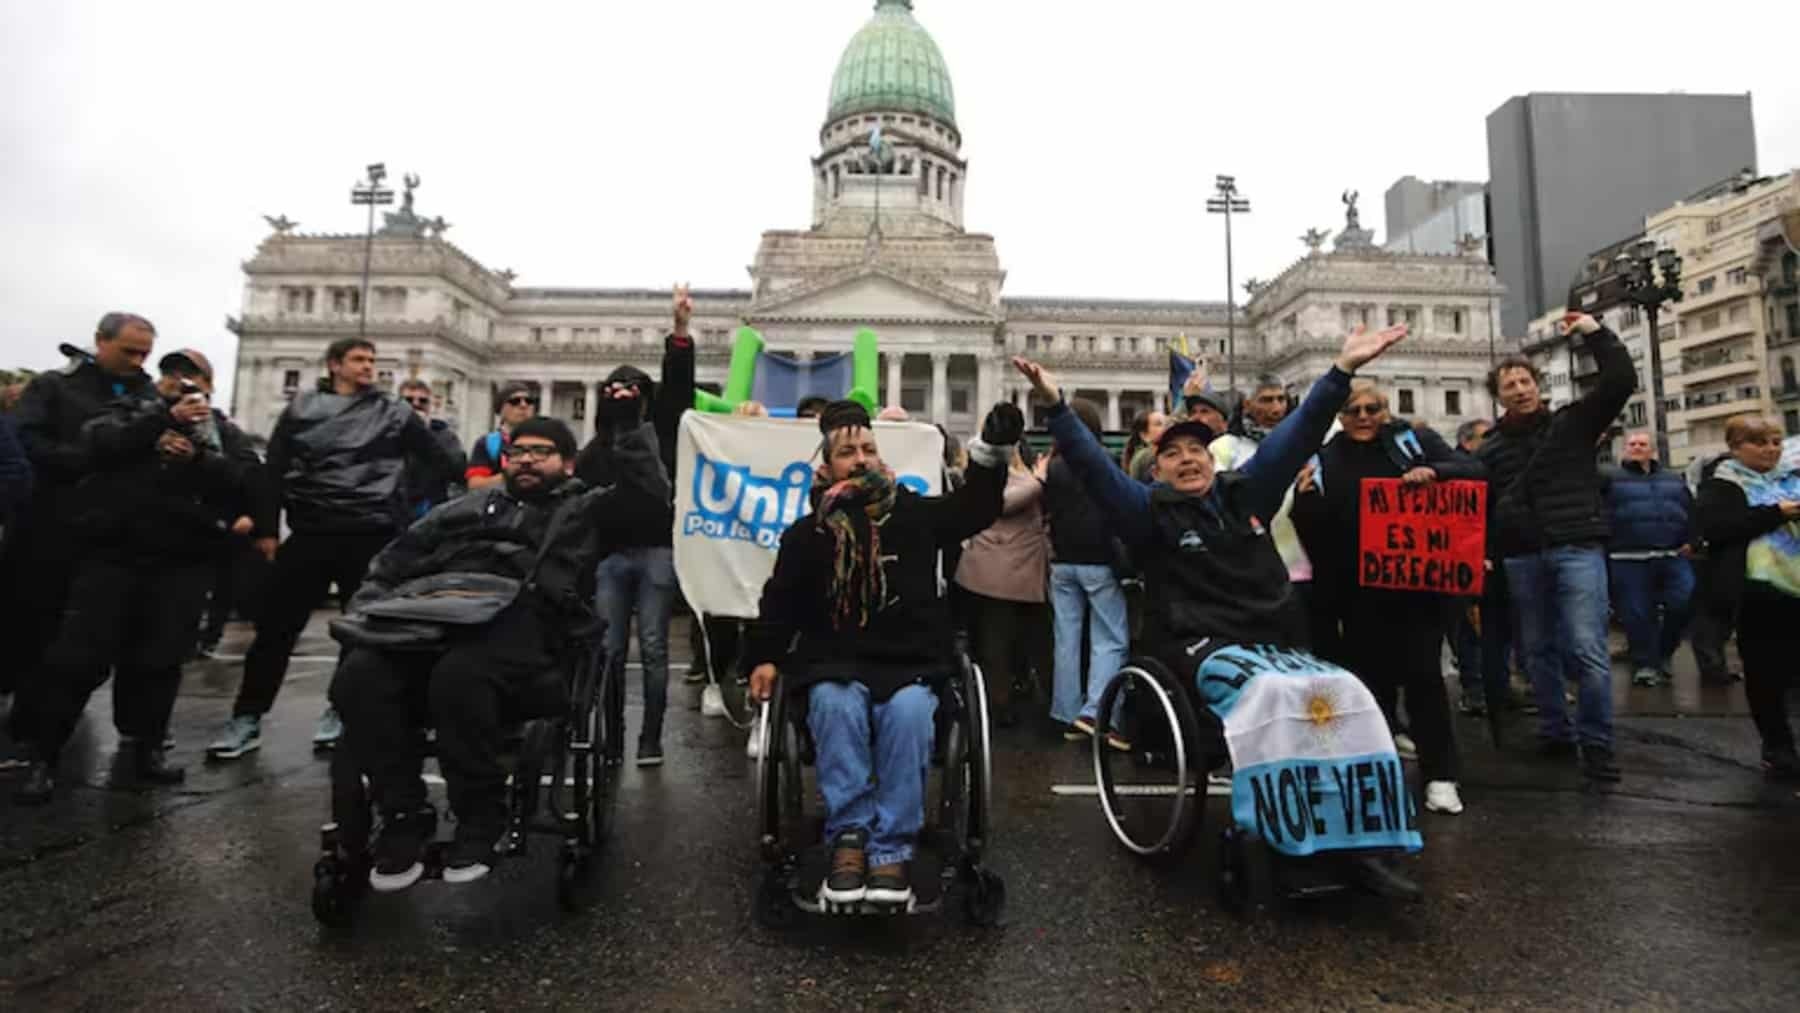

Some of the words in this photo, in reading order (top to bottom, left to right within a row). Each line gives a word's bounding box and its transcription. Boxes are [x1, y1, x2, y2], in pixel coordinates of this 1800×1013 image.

[1386, 523, 1416, 550] ES
[1363, 551, 1473, 591] DERECHO
[1250, 767, 1306, 844] NO
